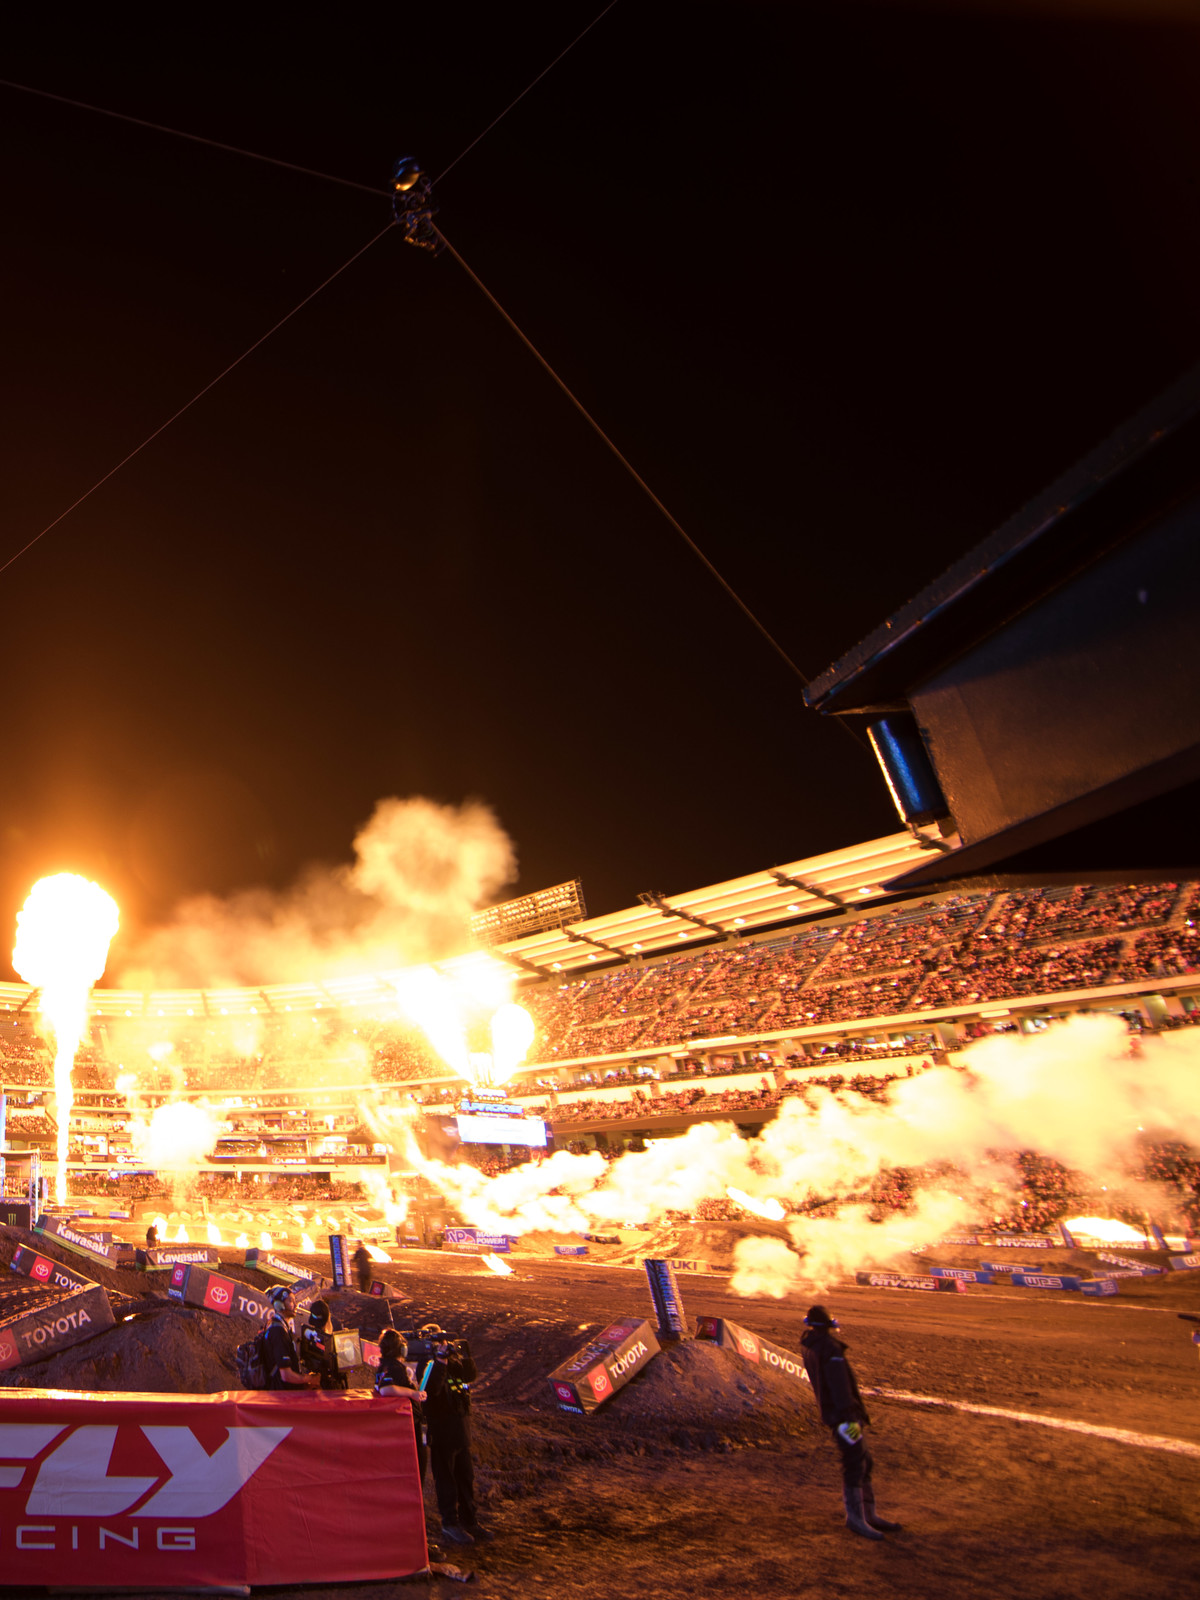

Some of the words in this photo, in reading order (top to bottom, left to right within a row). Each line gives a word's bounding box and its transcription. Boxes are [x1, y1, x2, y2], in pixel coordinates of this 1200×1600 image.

[56, 1223, 110, 1257] Kawasaki
[476, 1237, 506, 1245] POWER!
[156, 1250, 208, 1264] Kawasaki
[267, 1252, 313, 1281] Kawasaki
[1024, 1276, 1064, 1289] WPS
[21, 1308, 92, 1350] TOYOTA
[609, 1340, 648, 1380] TOYOTA
[761, 1347, 811, 1383] TOYOTA
